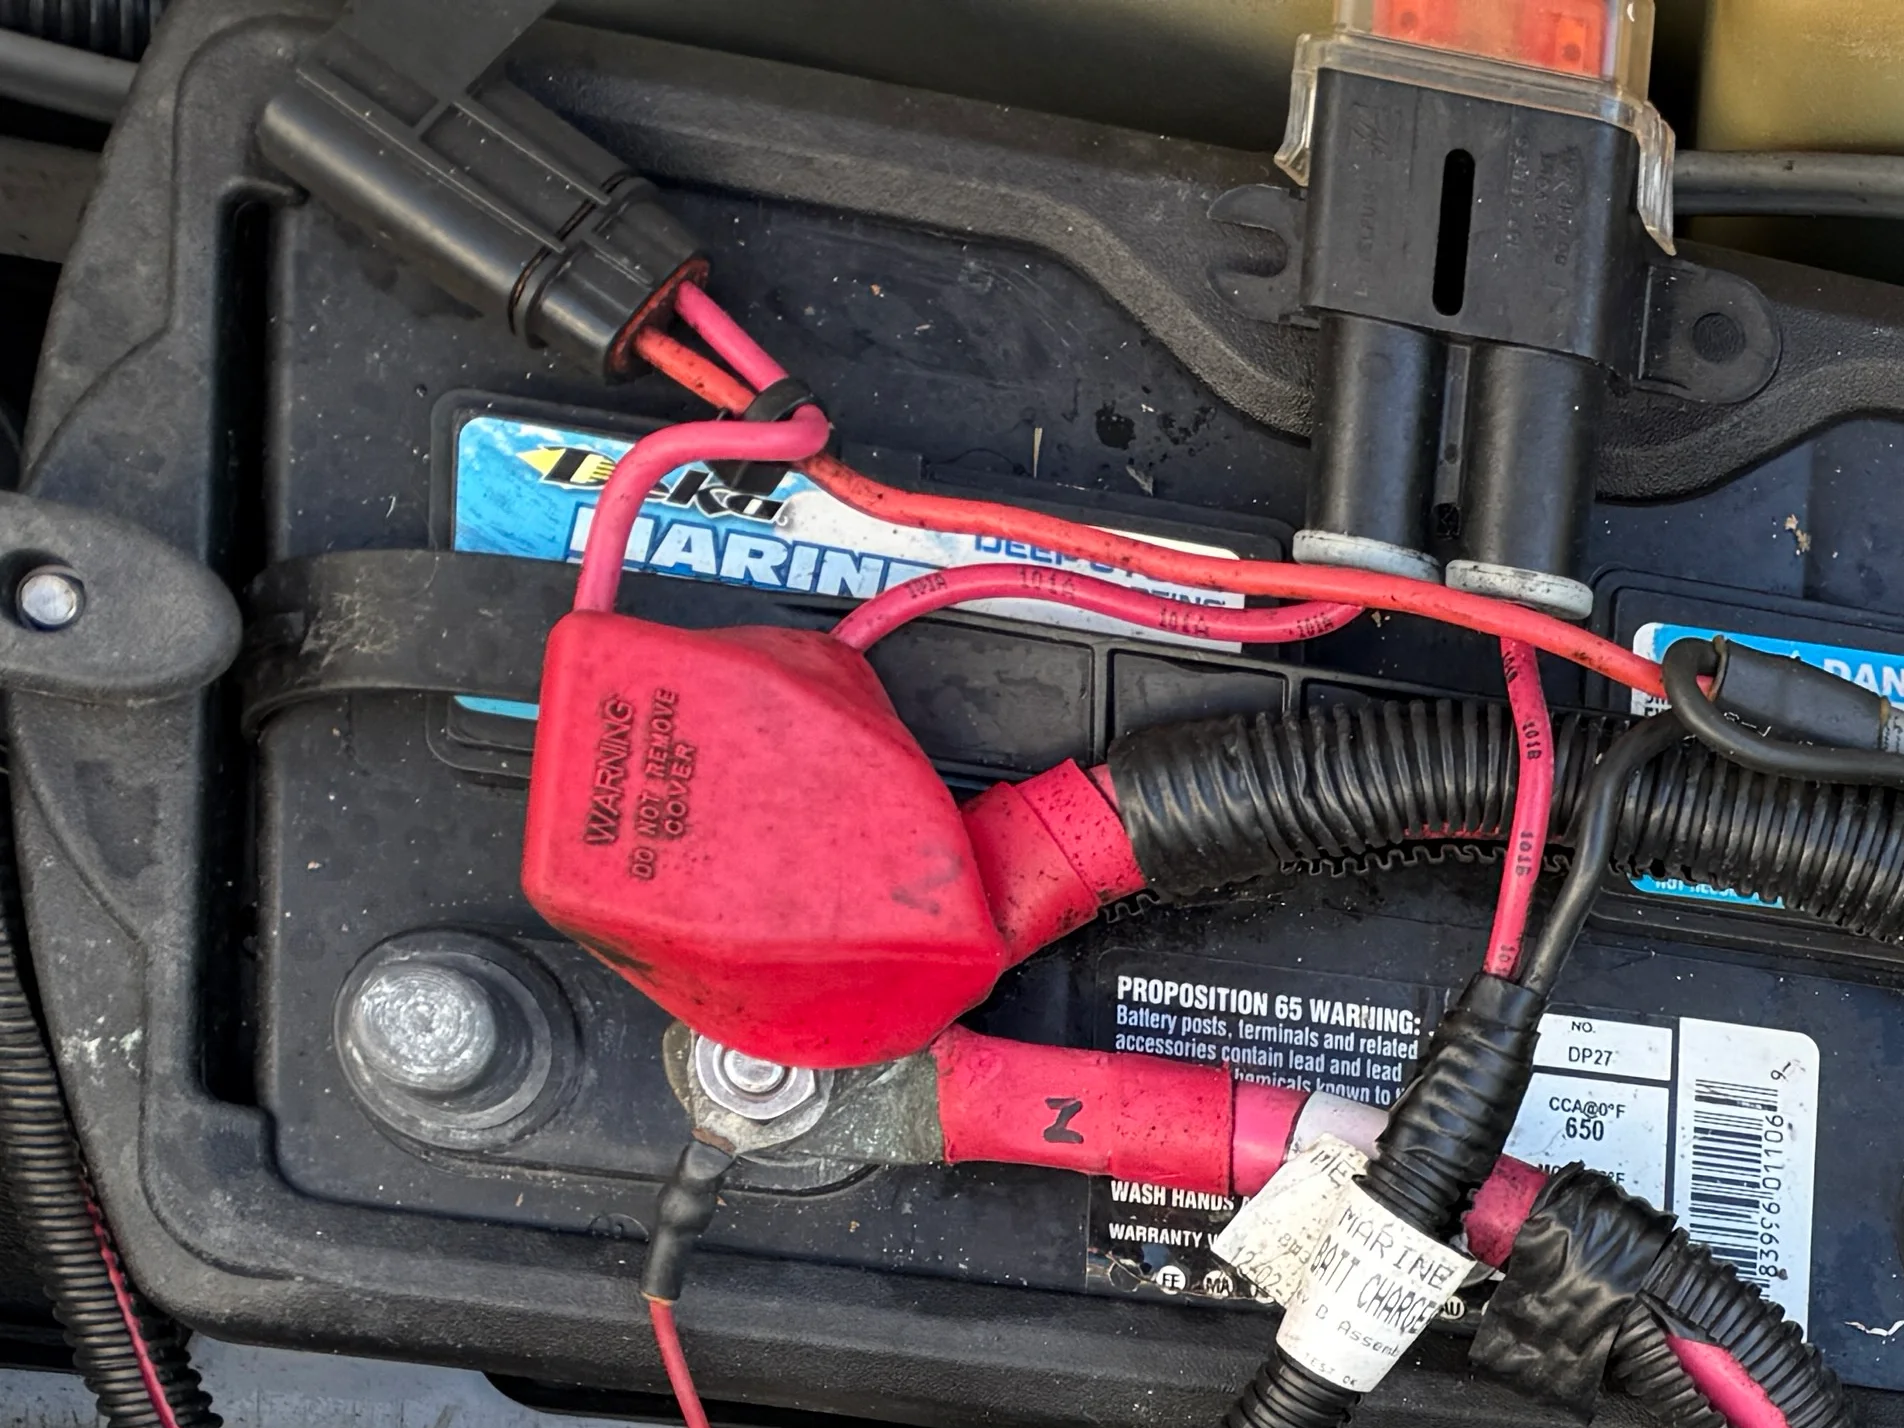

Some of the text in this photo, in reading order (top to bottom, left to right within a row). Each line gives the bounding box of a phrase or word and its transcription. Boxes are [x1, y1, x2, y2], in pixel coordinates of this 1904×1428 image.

[585, 694, 633, 845] WARNING
[631, 688, 678, 879] DO NOT REMOVE
[664, 743, 696, 836] COVER
[1116, 1004, 1419, 1061] Battery posts, terminals and related
[1117, 975, 1421, 1036] PROPOSITION 65 WARNING:
[1115, 1031, 1402, 1083] accessories contain lead and lead
[1567, 1045, 1613, 1067] DP27
[1564, 1116, 1605, 1142] 650
[1110, 1179, 1167, 1206] WASH
[1171, 1186, 1235, 1211] HANDS
[1108, 1221, 1203, 1250] WARRANTY
[1336, 1204, 1455, 1291] MARINE
